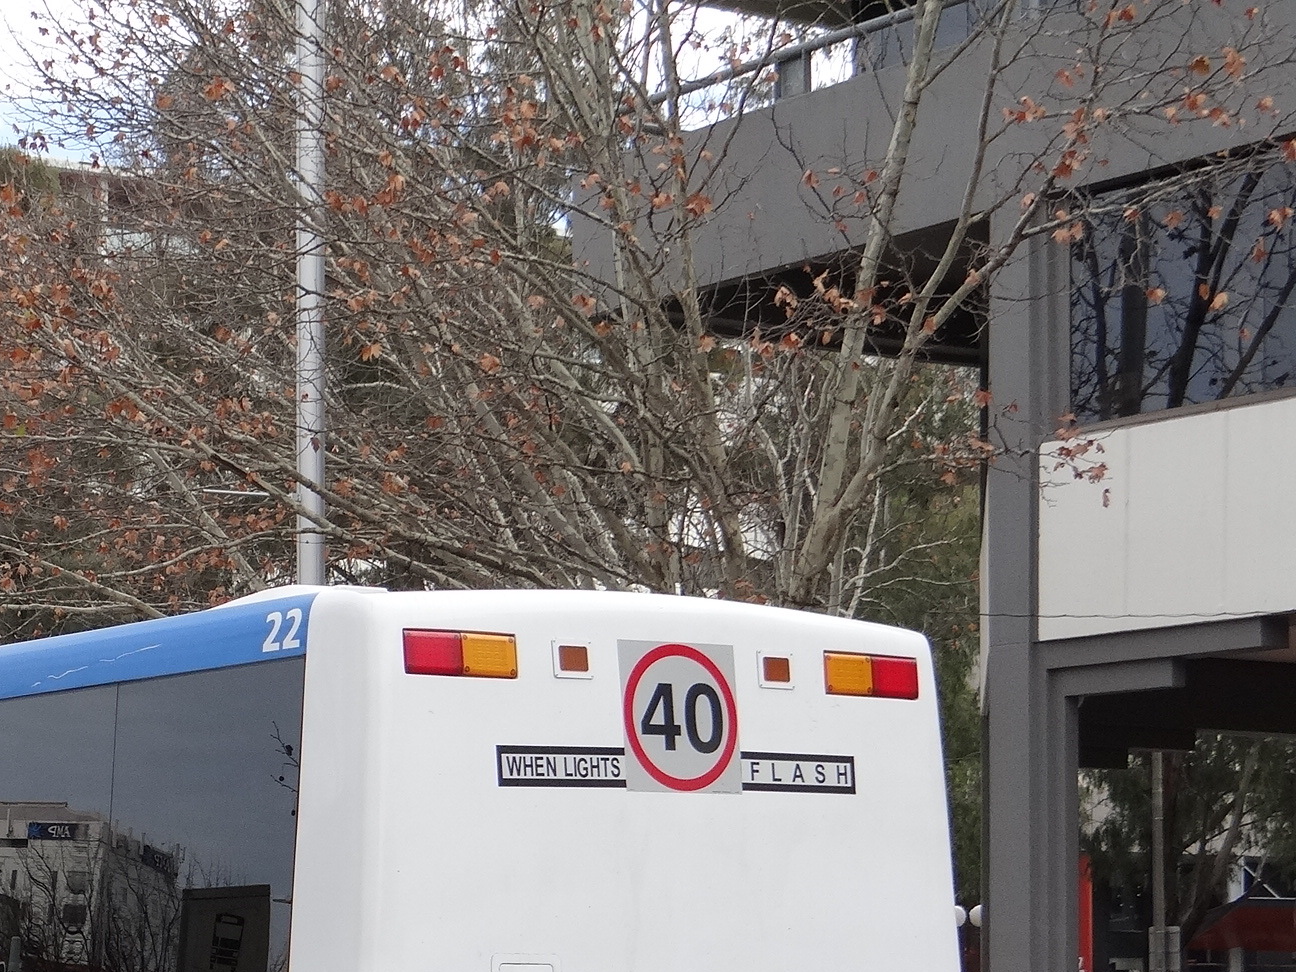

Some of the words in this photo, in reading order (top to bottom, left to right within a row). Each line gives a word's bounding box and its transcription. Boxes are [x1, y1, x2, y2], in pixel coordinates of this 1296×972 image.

[262, 608, 302, 652] 22
[641, 683, 723, 754] 40
[506, 756, 557, 777] WHEN
[564, 757, 621, 778] LIGHTS
[750, 762, 848, 784] FLASH
